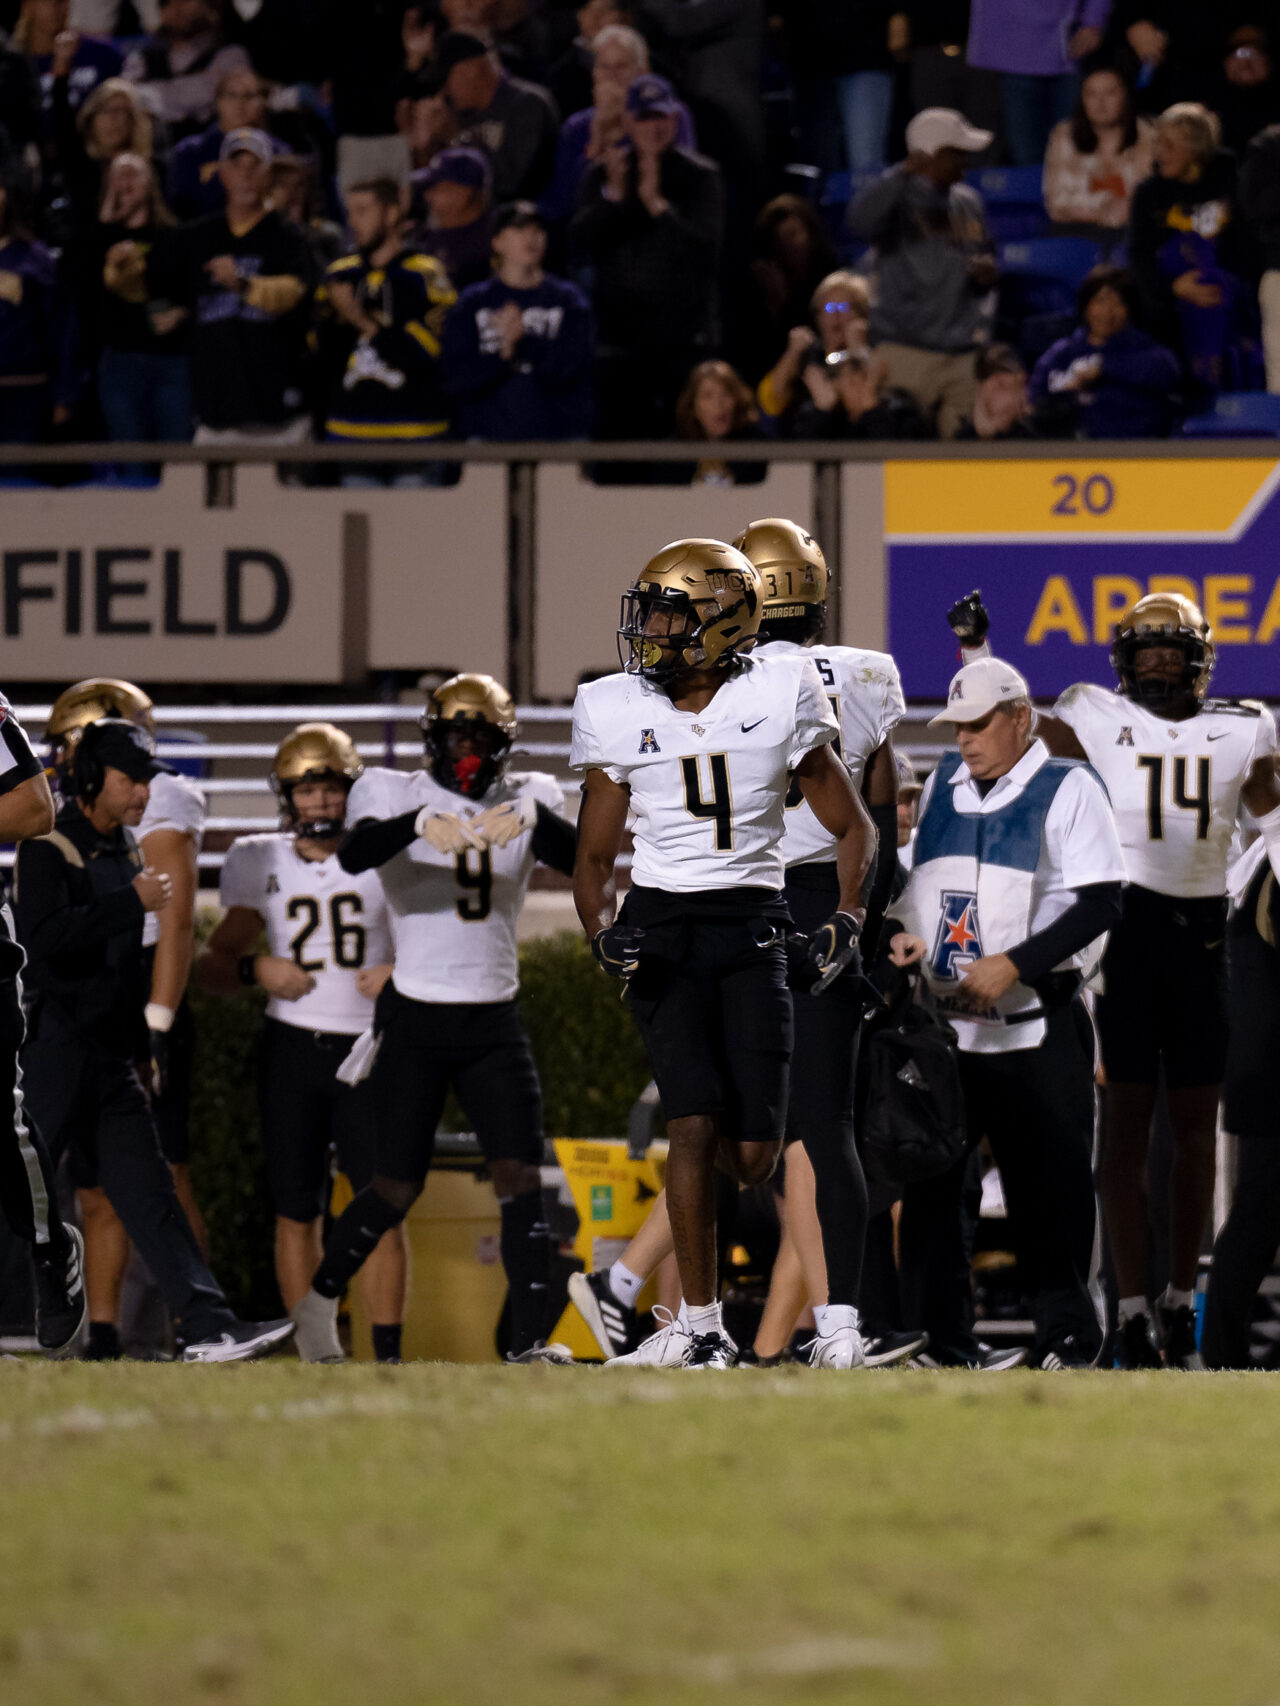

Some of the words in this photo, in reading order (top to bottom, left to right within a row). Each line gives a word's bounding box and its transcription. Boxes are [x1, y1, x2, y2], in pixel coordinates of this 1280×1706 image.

[1052, 474, 1114, 515] 20
[4, 547, 292, 636] FIELD
[765, 571, 793, 597] 31
[678, 751, 736, 853] 4
[1136, 752, 1214, 841] 14
[455, 845, 493, 922] 9
[287, 893, 366, 972] 26
